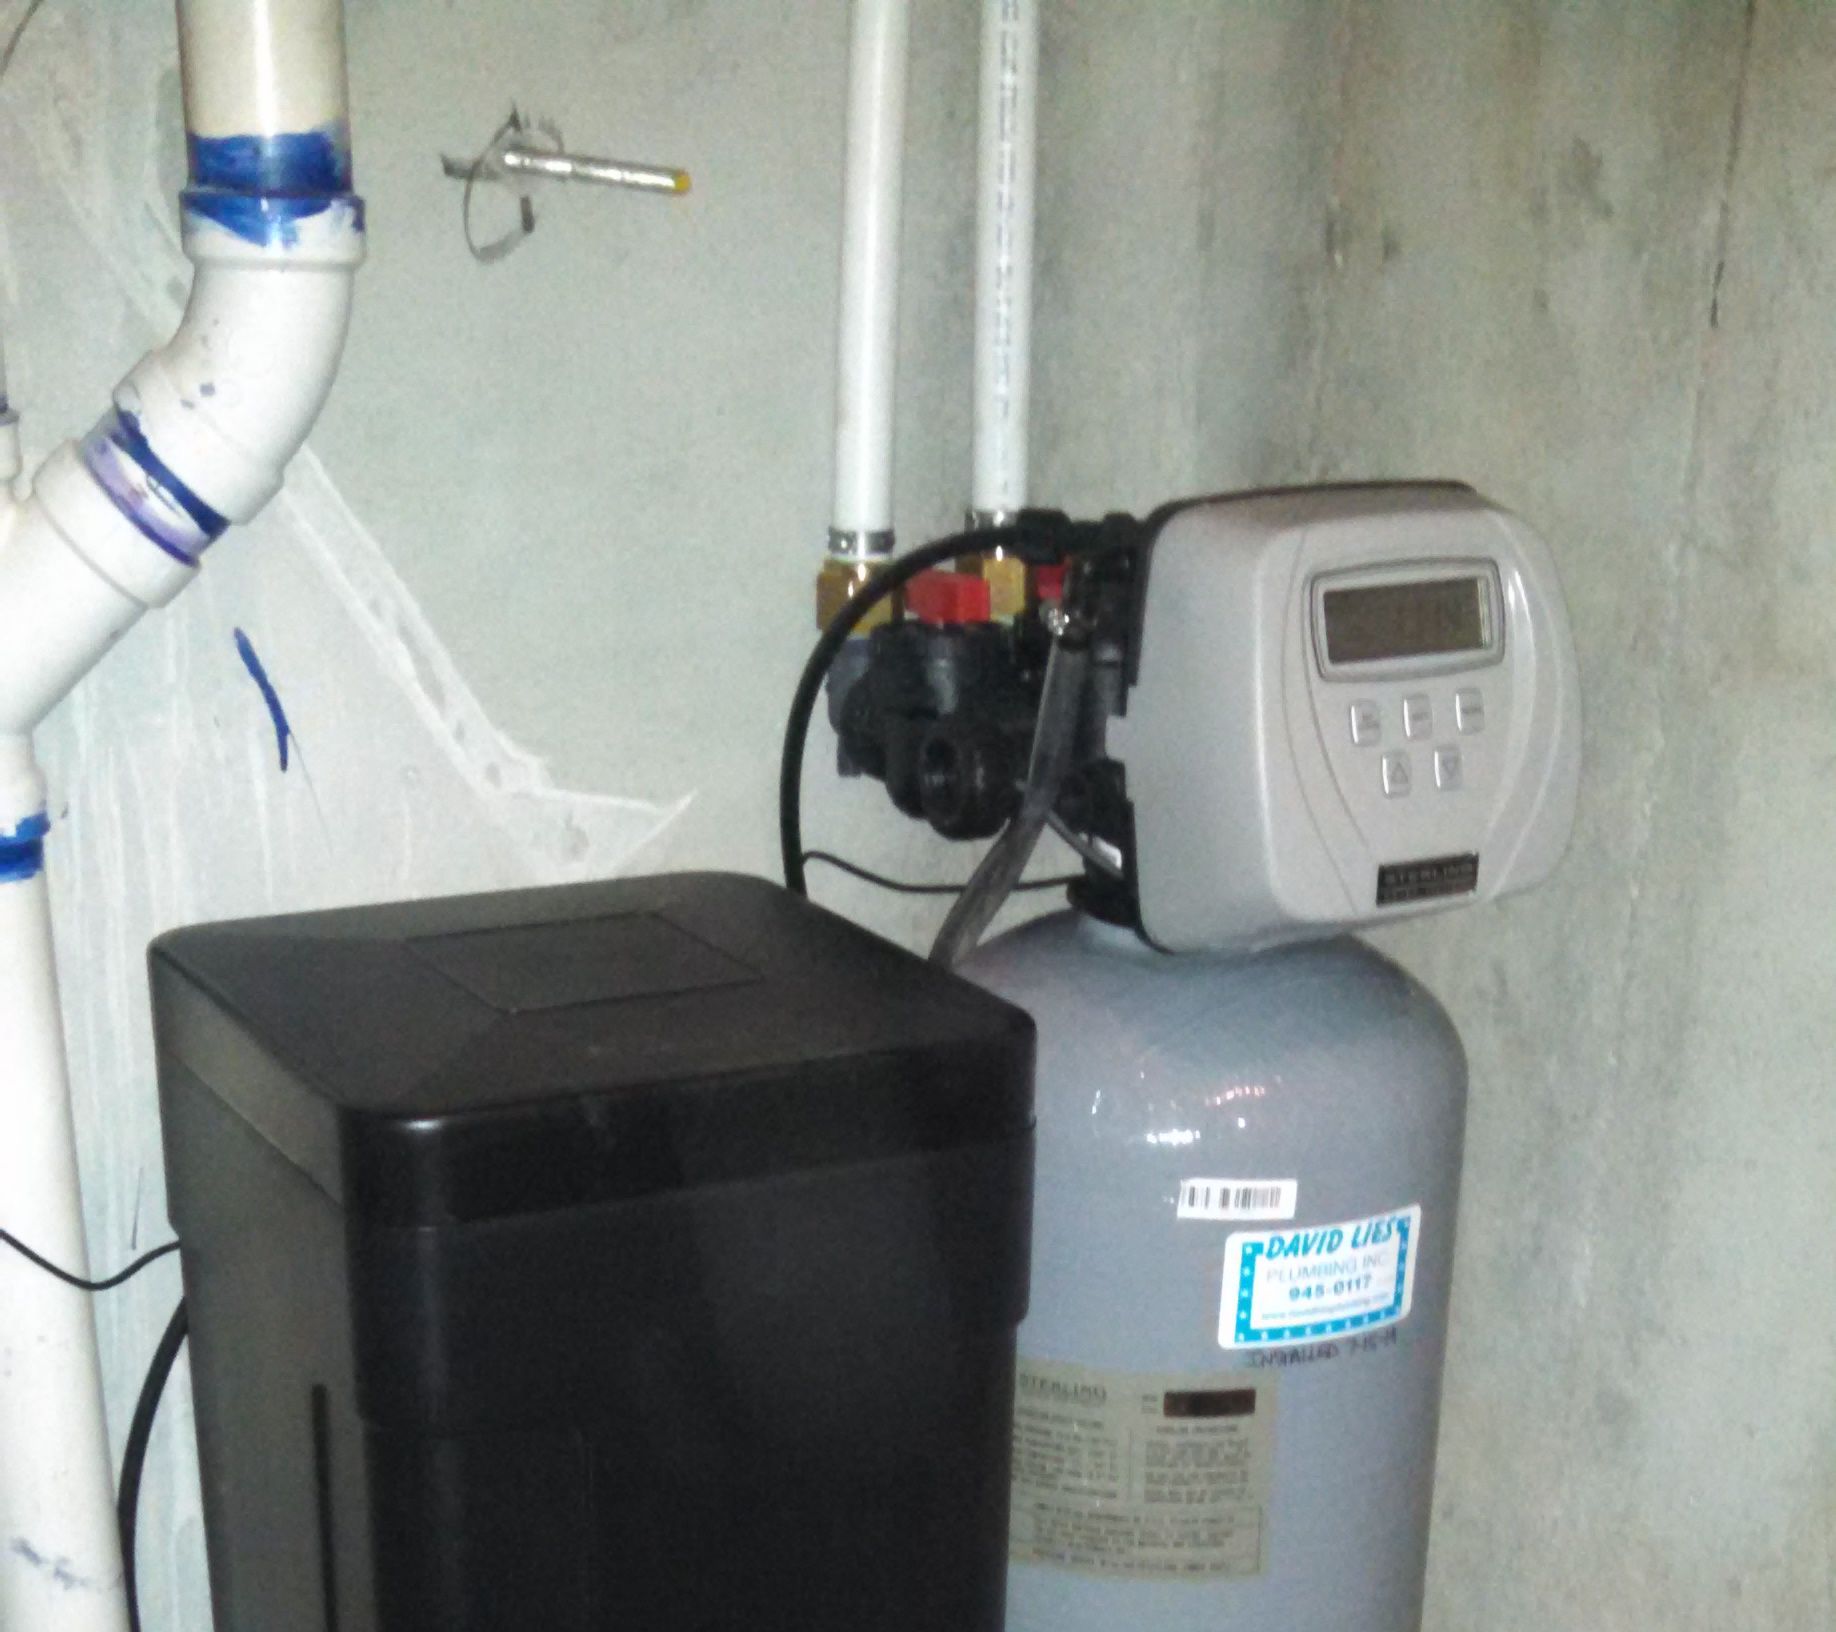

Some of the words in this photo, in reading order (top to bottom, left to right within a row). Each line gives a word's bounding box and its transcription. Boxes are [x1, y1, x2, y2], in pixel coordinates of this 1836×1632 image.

[1266, 1228, 1344, 1259] DAVID
[1351, 1215, 1396, 1249] LIES
[1266, 1256, 1357, 1282] PLUMBING
[1289, 1273, 1372, 1301] 945-0117
